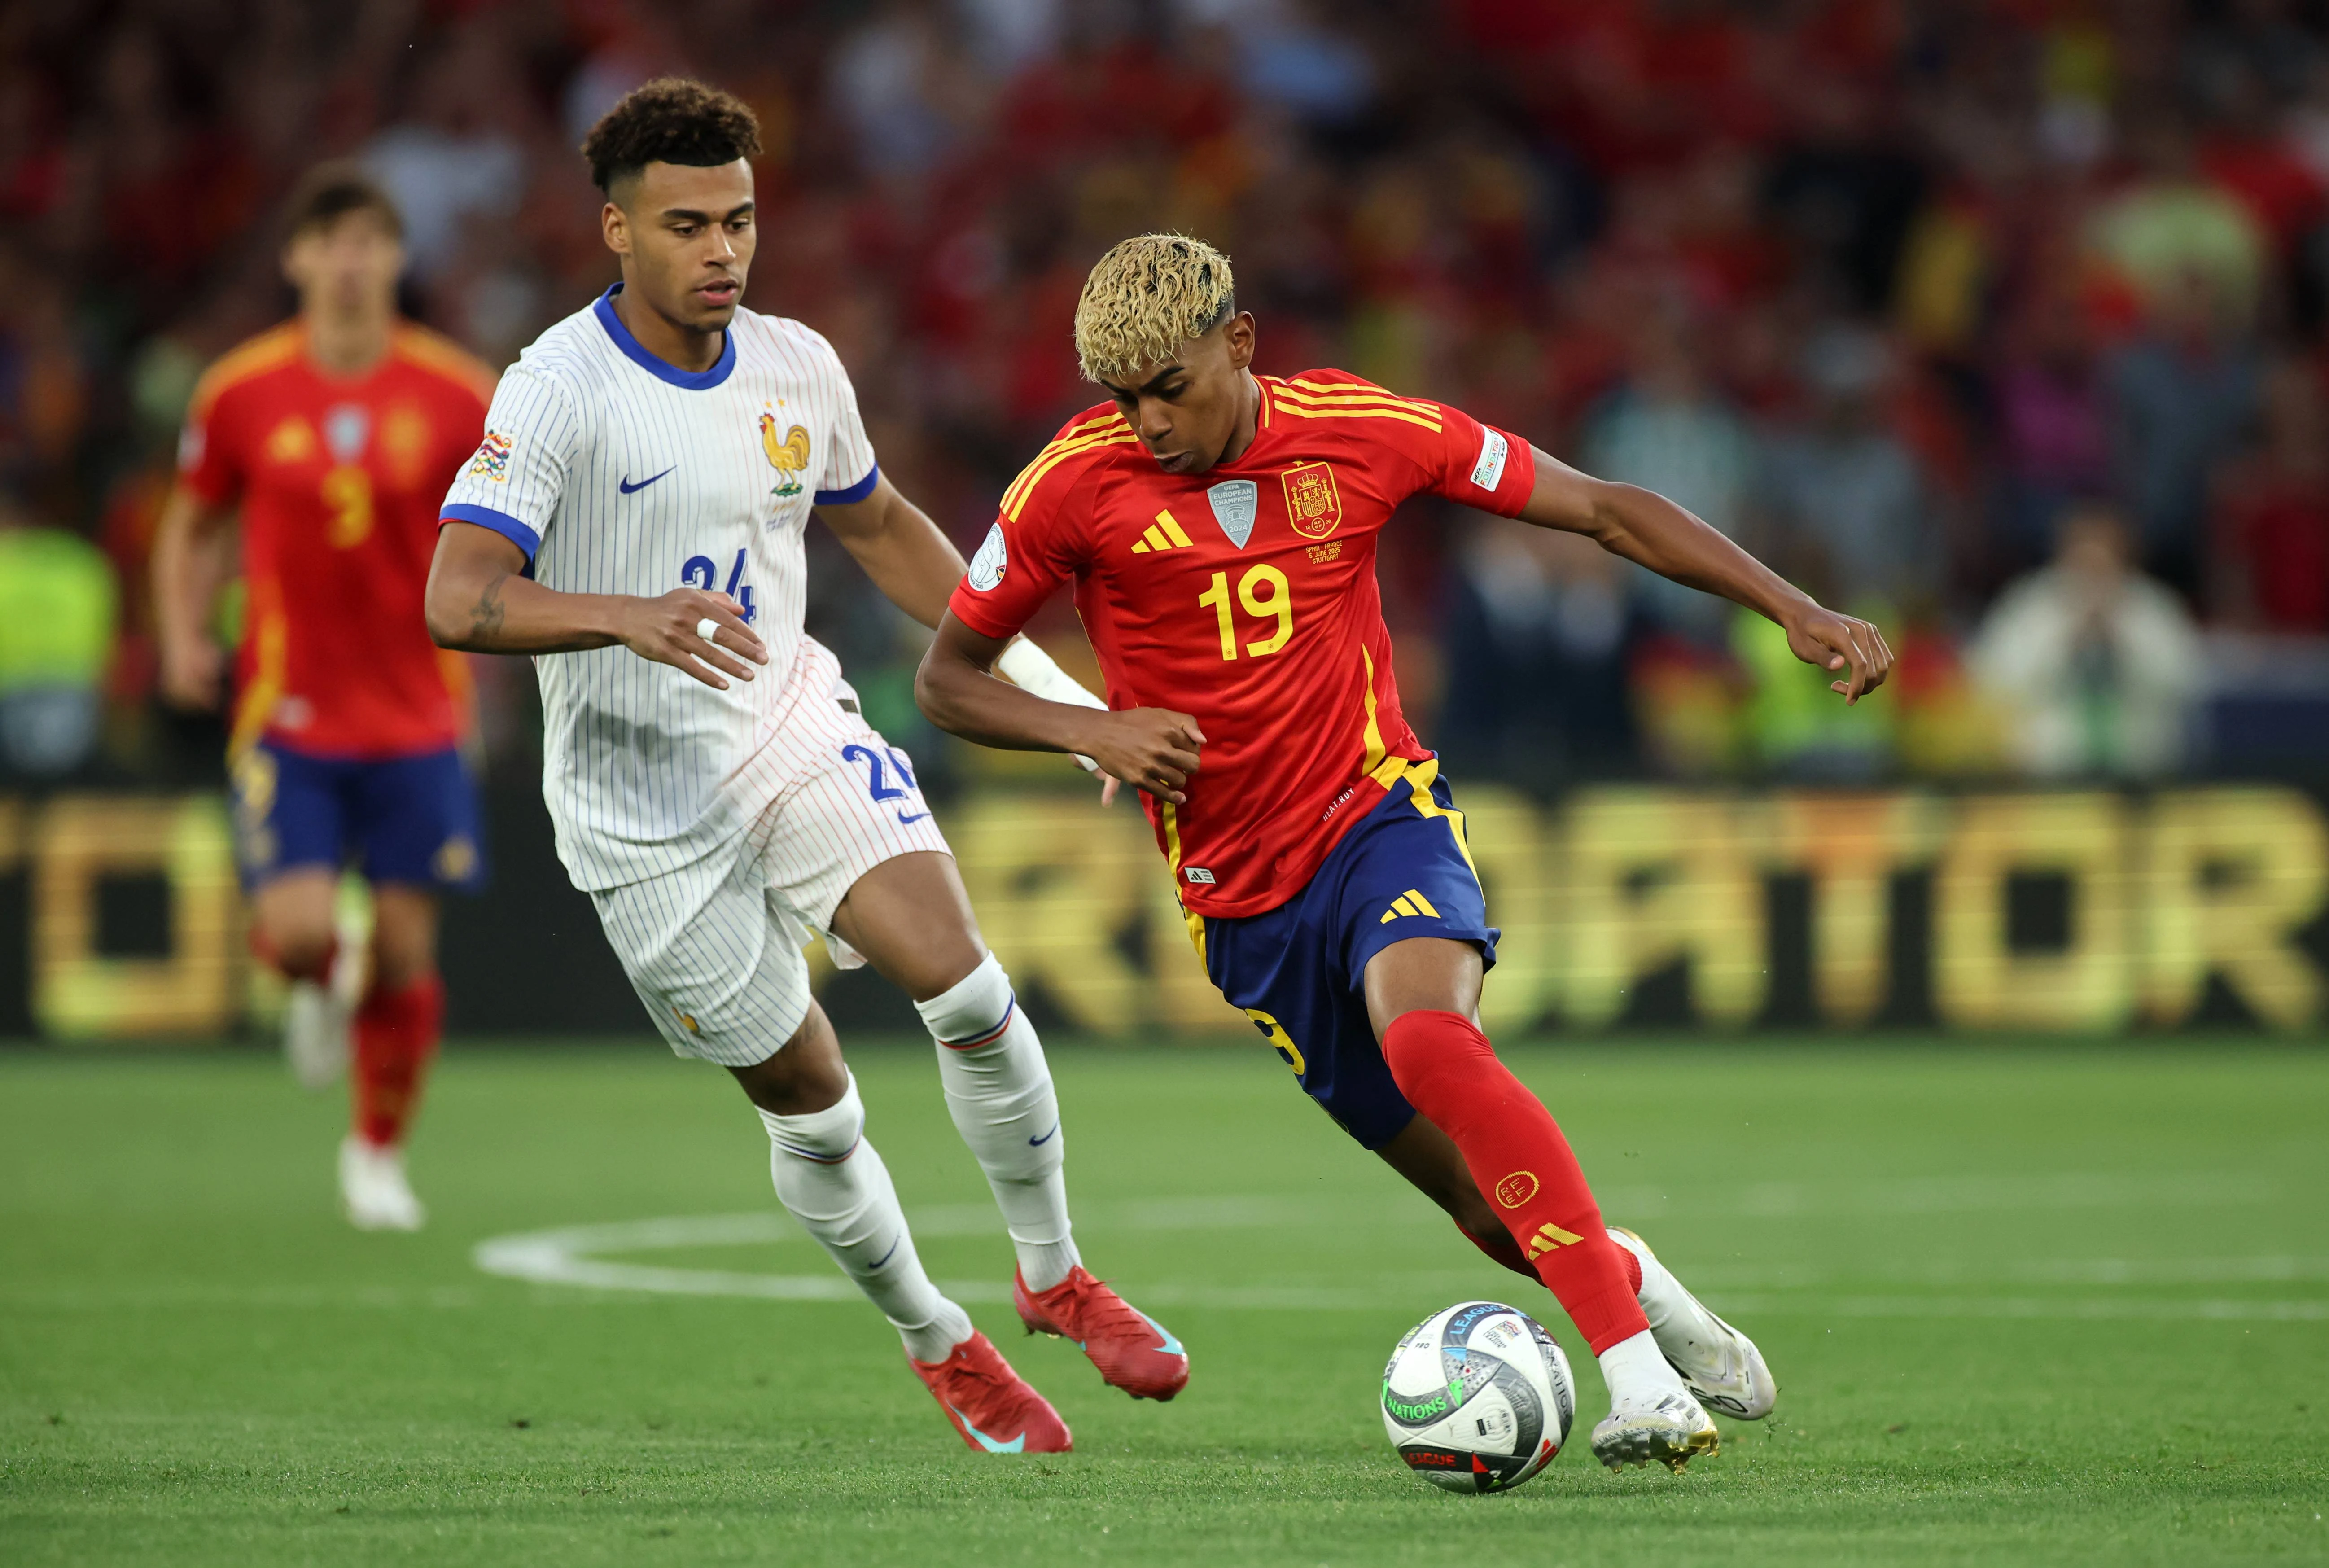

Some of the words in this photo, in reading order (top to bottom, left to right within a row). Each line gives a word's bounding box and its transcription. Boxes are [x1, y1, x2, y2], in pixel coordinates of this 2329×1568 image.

[1480, 436, 1500, 486] FOUNDATION
[1473, 468, 1482, 482] UEFA
[1213, 488, 1252, 500] EUROPEAN
[1214, 495, 1253, 506] CHAMPIONS
[1229, 524, 1248, 533] 2024
[1305, 545, 1320, 553] SPAIN
[1324, 540, 1343, 549] FRANCE
[1315, 549, 1327, 557] JUNE
[1328, 547, 1341, 555] 2025
[1312, 553, 1339, 564] STUTTGART
[1199, 564, 1293, 661] 19
[1450, 1305, 1503, 1335] LEAGUE
[1387, 1395, 1447, 1419] NATIONS
